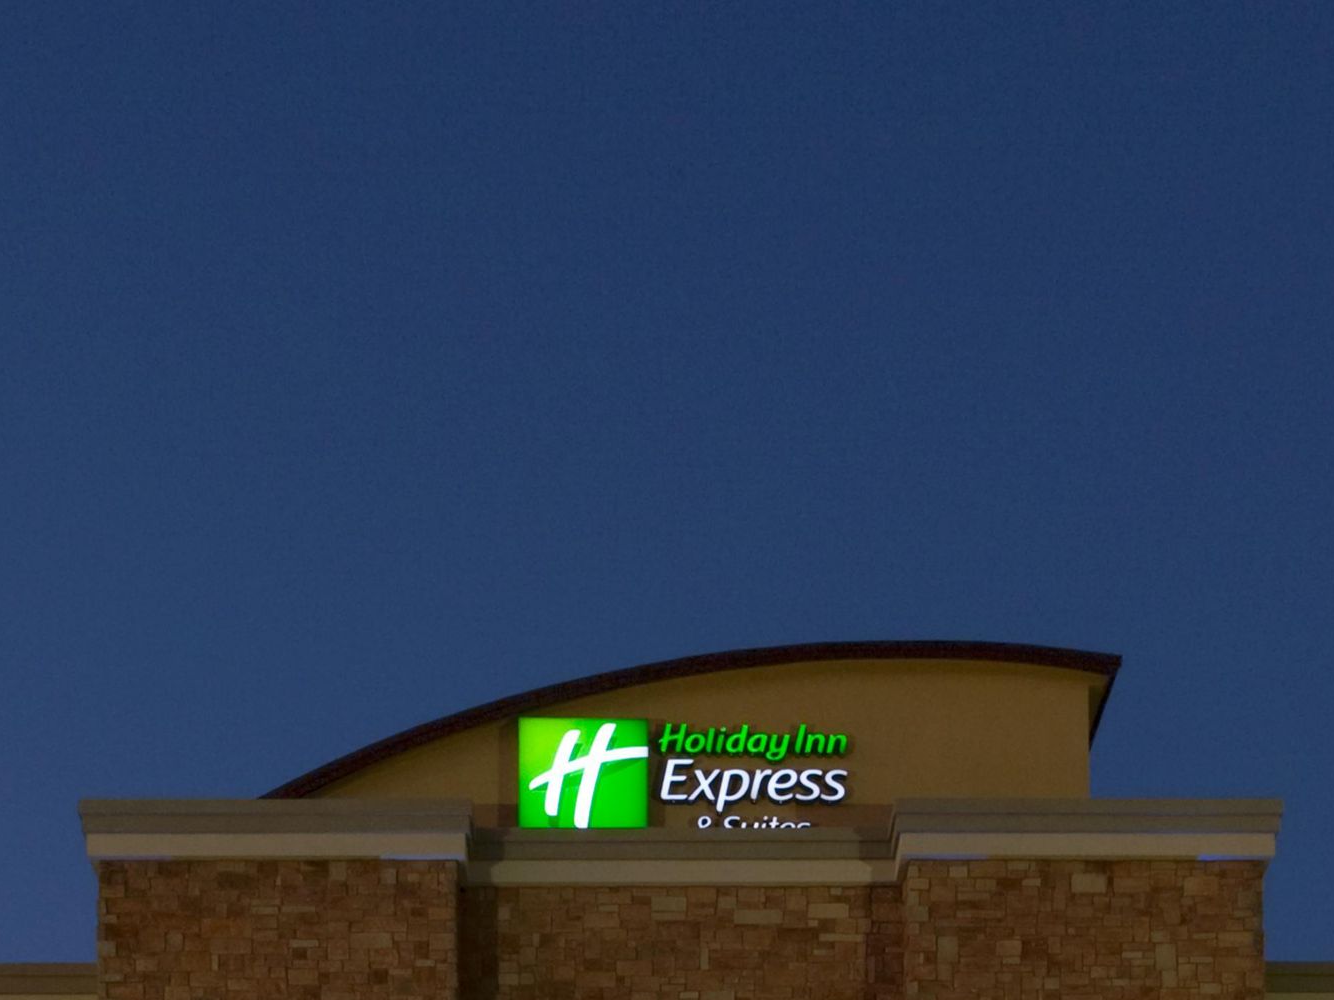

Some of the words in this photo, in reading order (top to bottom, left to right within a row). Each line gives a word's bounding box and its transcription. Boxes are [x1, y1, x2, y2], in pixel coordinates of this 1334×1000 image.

[658, 723, 791, 761] Holiday
[794, 723, 848, 754] Inn
[660, 758, 848, 813] Express
